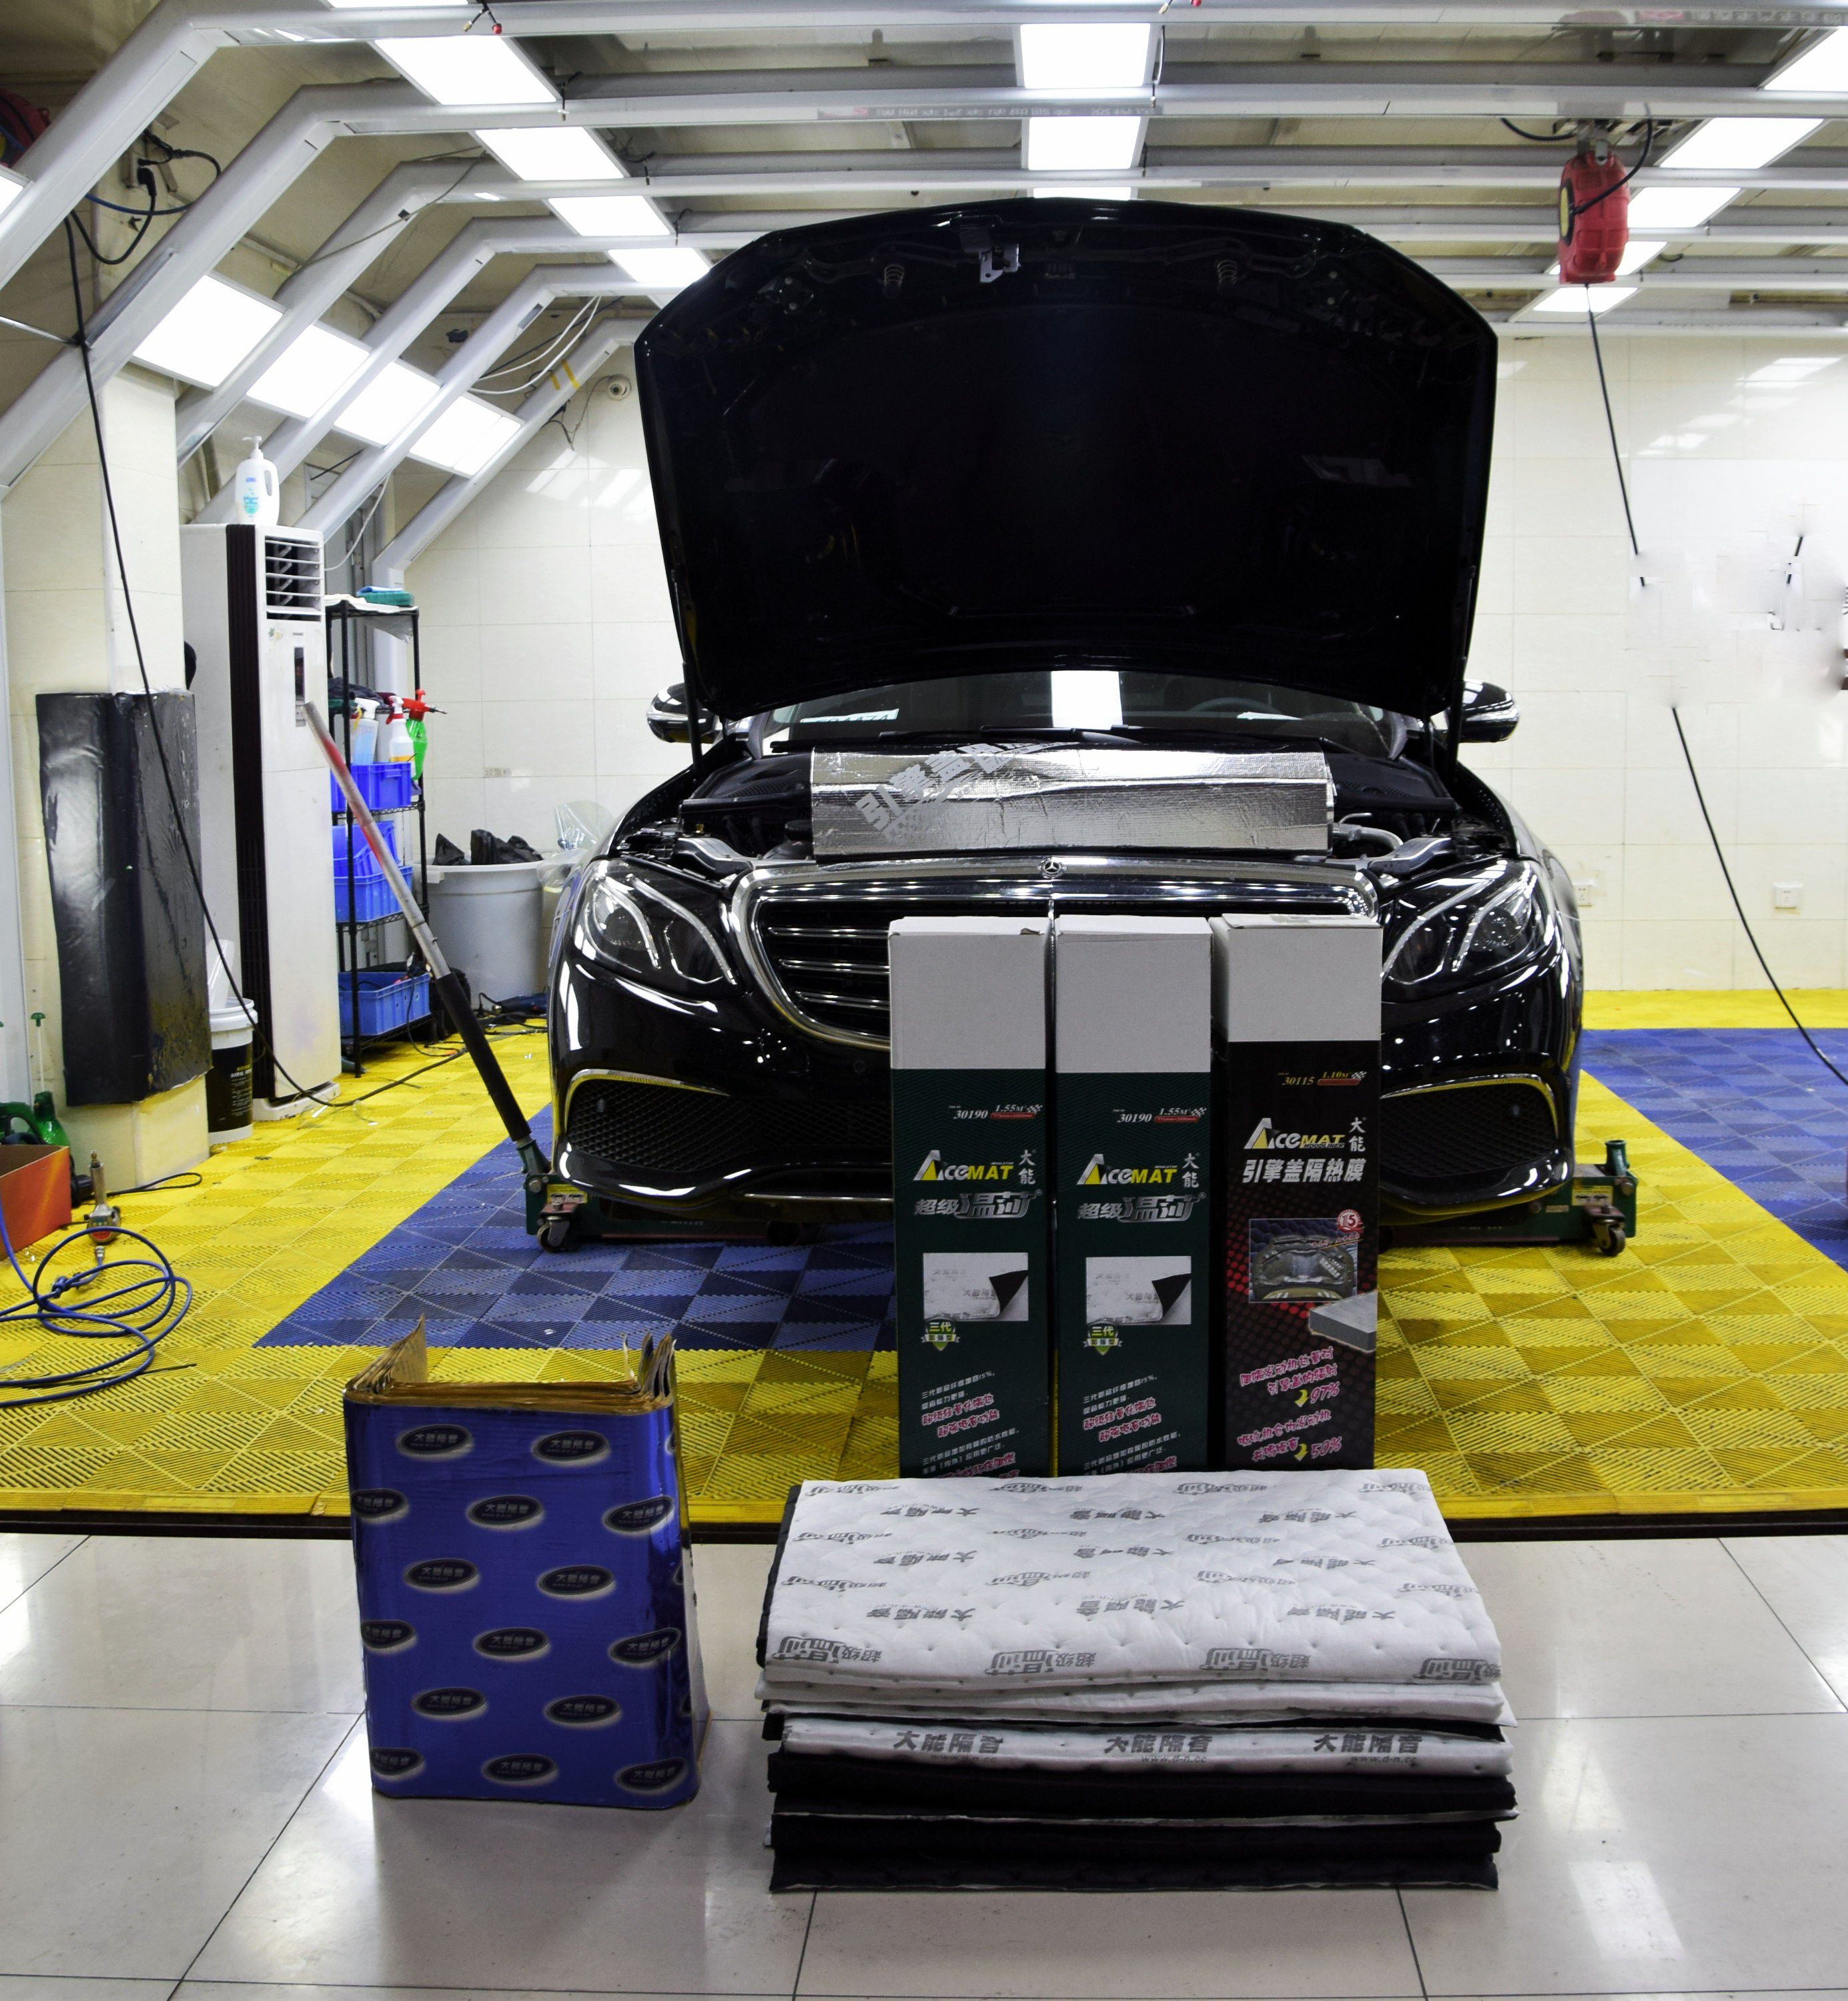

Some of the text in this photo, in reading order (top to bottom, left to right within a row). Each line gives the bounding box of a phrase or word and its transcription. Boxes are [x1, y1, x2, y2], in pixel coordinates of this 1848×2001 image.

[1282, 1077, 1315, 1085] 30115
[953, 1110, 989, 1119] 30190
[1117, 1113, 1153, 1123] 30190
[1349, 1117, 1366, 1152] 大能
[1018, 1149, 1036, 1185] 大能
[1182, 1153, 1200, 1188] 大能
[1242, 1159, 1367, 1183] 引擎盖隔热膜
[929, 1322, 952, 1332] 三代
[1092, 1326, 1115, 1336] 三代
[1310, 1382, 1340, 1404] 97%
[1311, 1436, 1342, 1459] 50%
[893, 1731, 1003, 1754] 大能隔音
[1104, 1734, 1213, 1754] 大能隔音
[1314, 1734, 1423, 1754] 大能隔音
